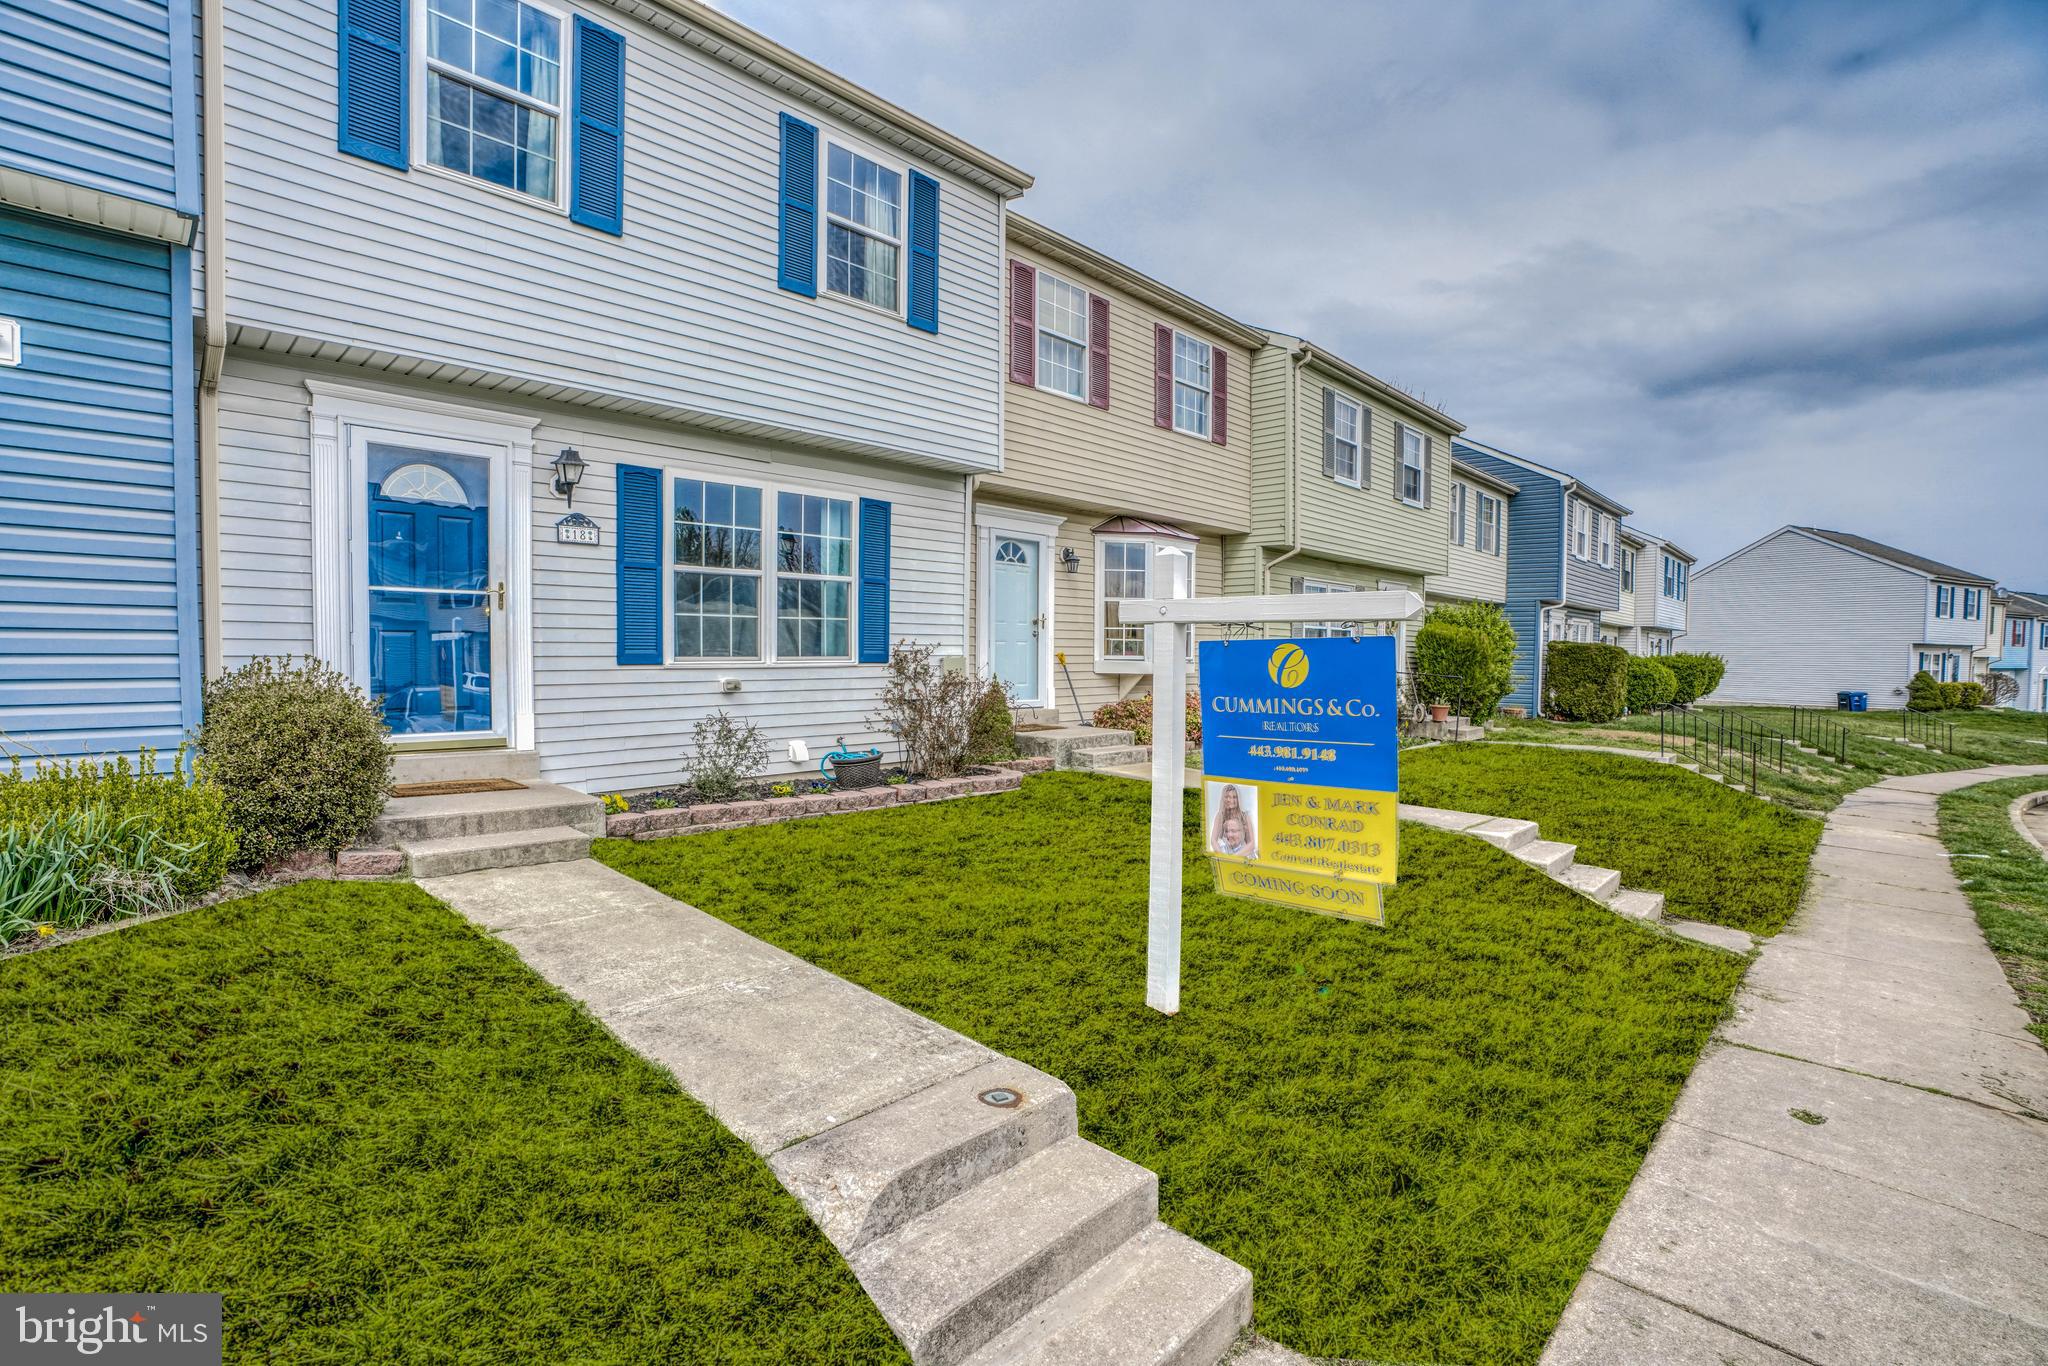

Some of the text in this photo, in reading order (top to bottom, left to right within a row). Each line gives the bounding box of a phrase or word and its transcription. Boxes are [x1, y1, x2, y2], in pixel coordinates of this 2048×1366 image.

[1262, 720, 1320, 733] REALTORS
[1305, 796, 1320, 809] &
[1323, 797, 1380, 816] MARK
[1286, 813, 1365, 833] CONRAD
[1232, 870, 1365, 906] COMING SOON
